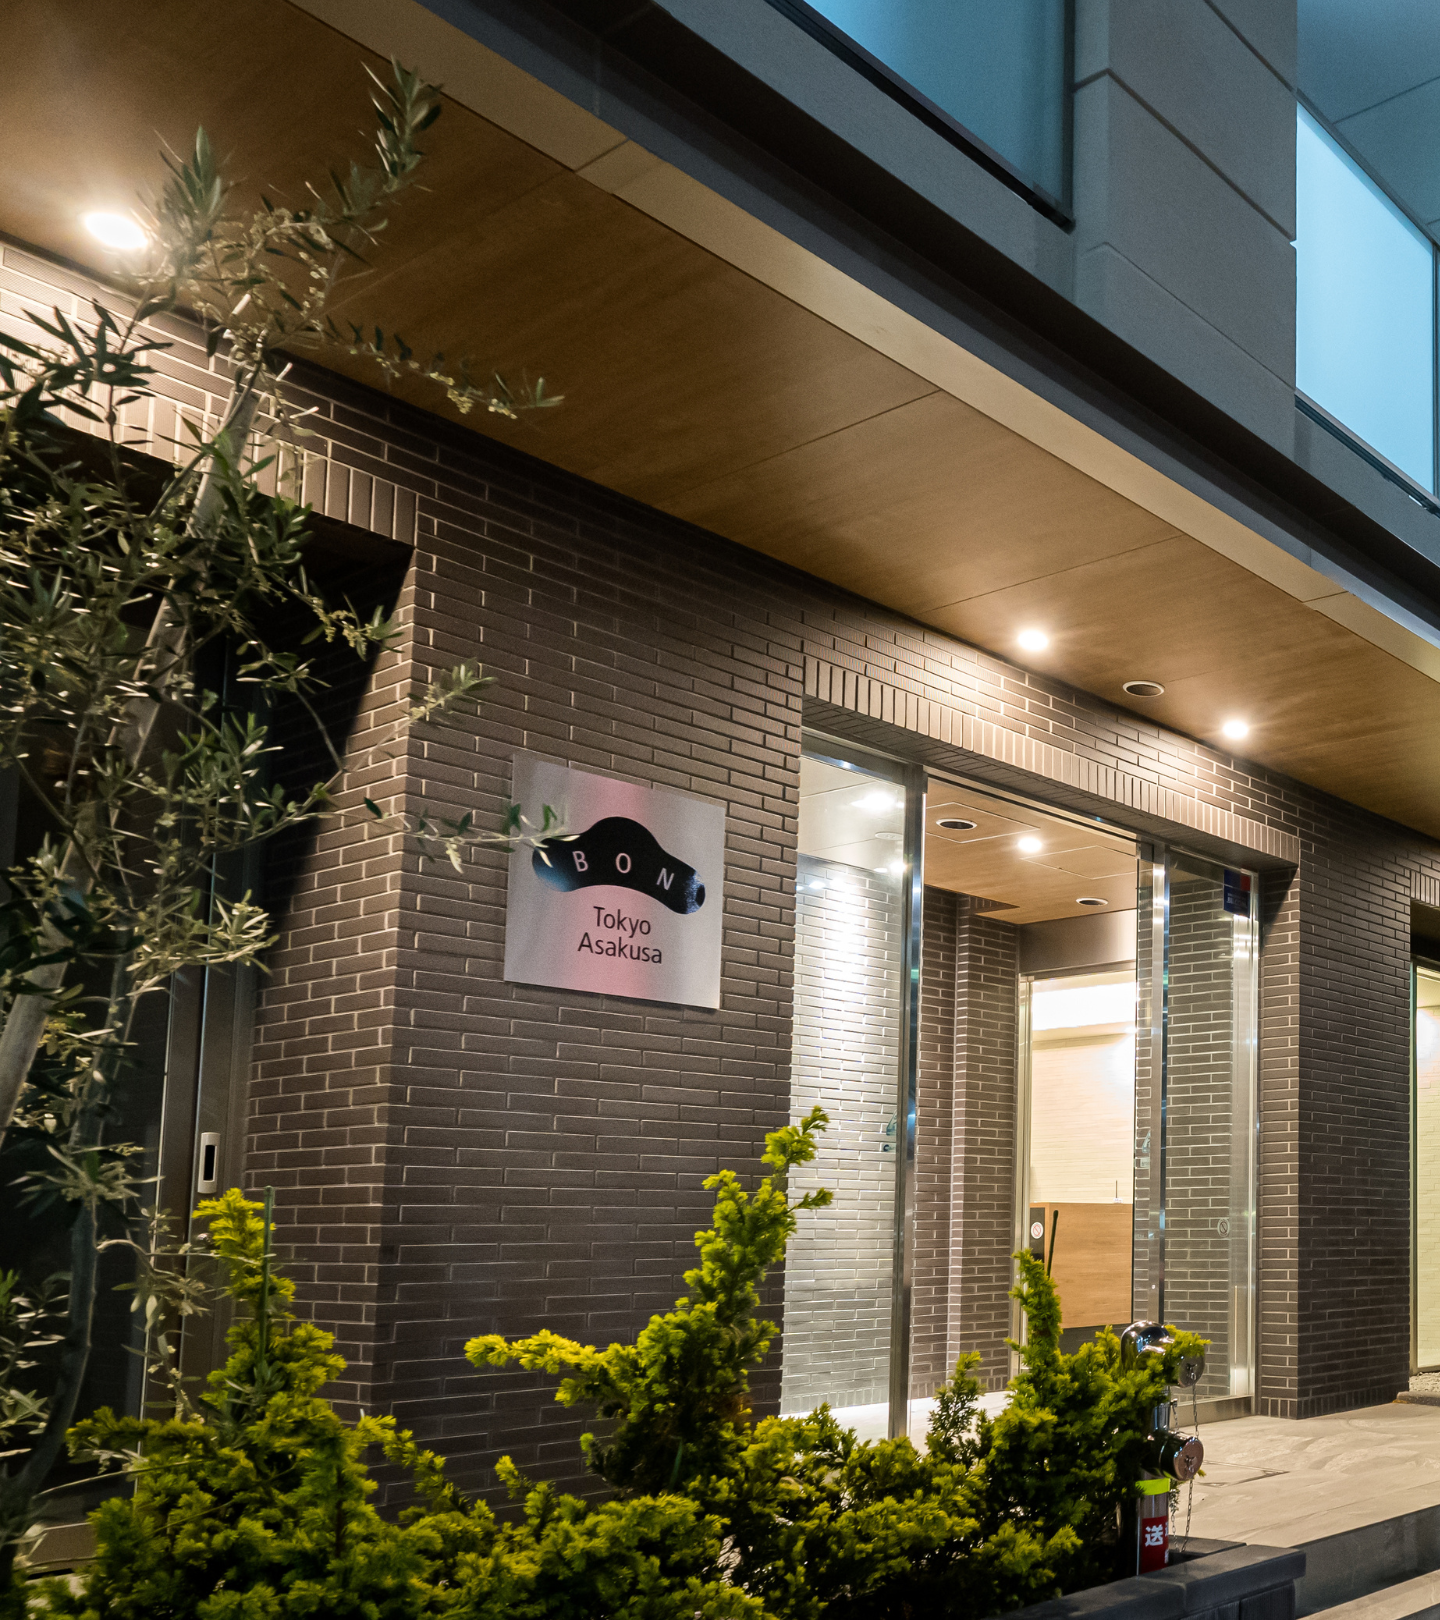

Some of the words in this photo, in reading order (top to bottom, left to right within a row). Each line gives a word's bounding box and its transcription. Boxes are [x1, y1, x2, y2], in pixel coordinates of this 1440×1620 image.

[572, 850, 675, 891] BON
[593, 905, 651, 938] Tokyo
[577, 932, 663, 964] Asakusa
